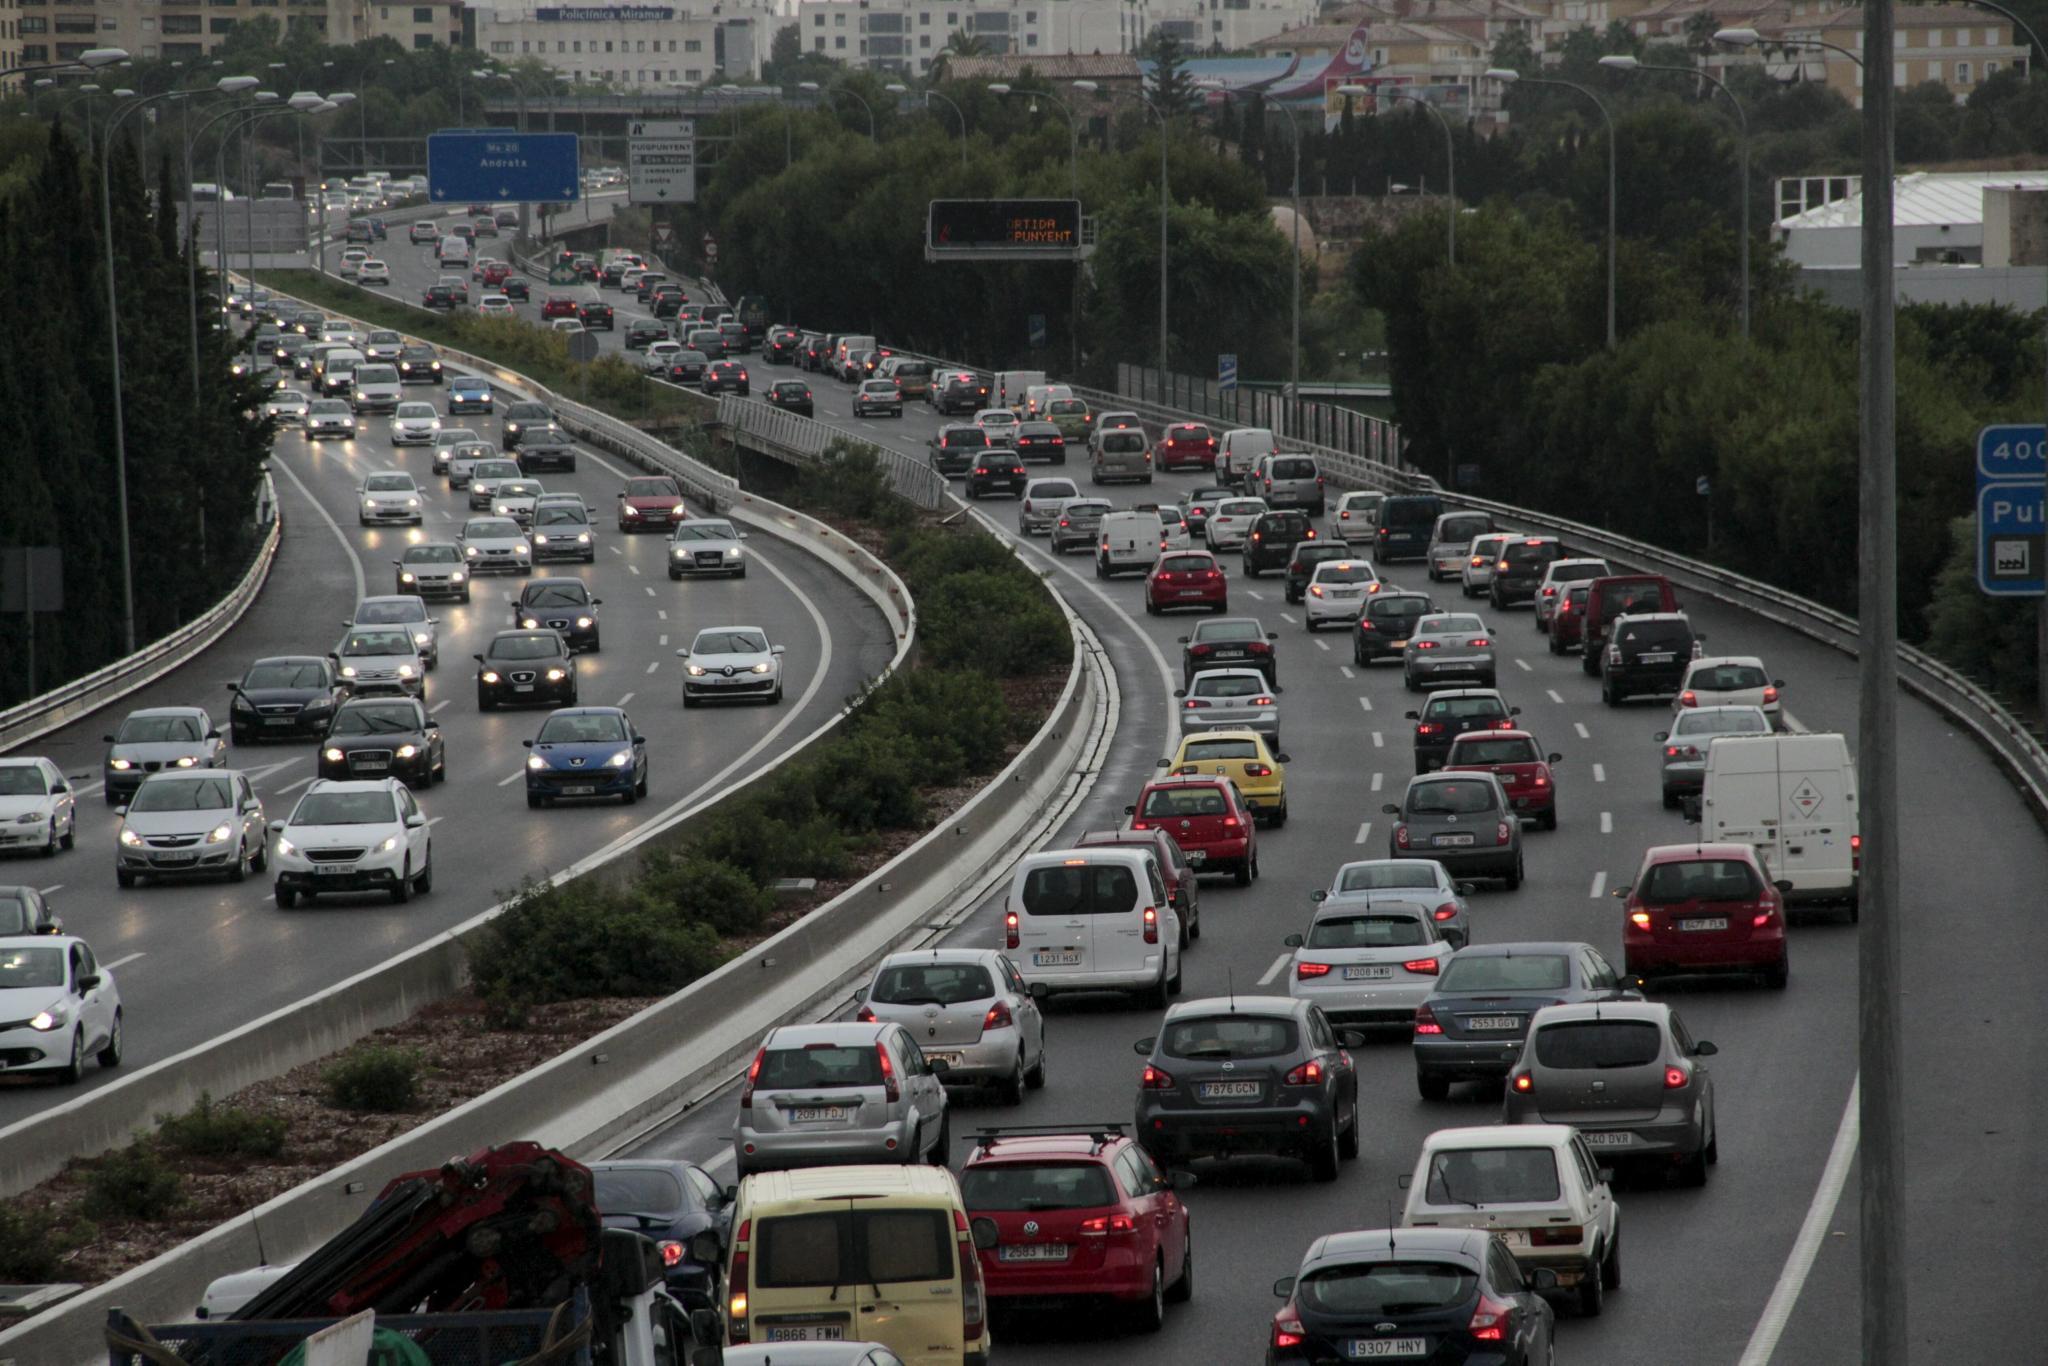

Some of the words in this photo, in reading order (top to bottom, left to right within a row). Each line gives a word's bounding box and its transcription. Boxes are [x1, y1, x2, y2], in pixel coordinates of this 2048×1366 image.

[560, 8, 616, 19] Policlínica
[620, 9, 664, 19] Miramar
[631, 143, 690, 151] PUIGPUNYENT
[1041, 955, 1060, 963] 1231
[1472, 1018, 1495, 1028] 2553
[1207, 1083, 1233, 1094] 7876
[1235, 1082, 1256, 1093] GCN
[797, 1109, 821, 1120] 2091
[1008, 1247, 1037, 1258] 2583
[1043, 1245, 1065, 1256] HHB
[775, 1327, 807, 1340] 9866
[816, 1327, 841, 1339] FWM
[1358, 1341, 1391, 1355] 9307
[1396, 1340, 1421, 1353] HNY
